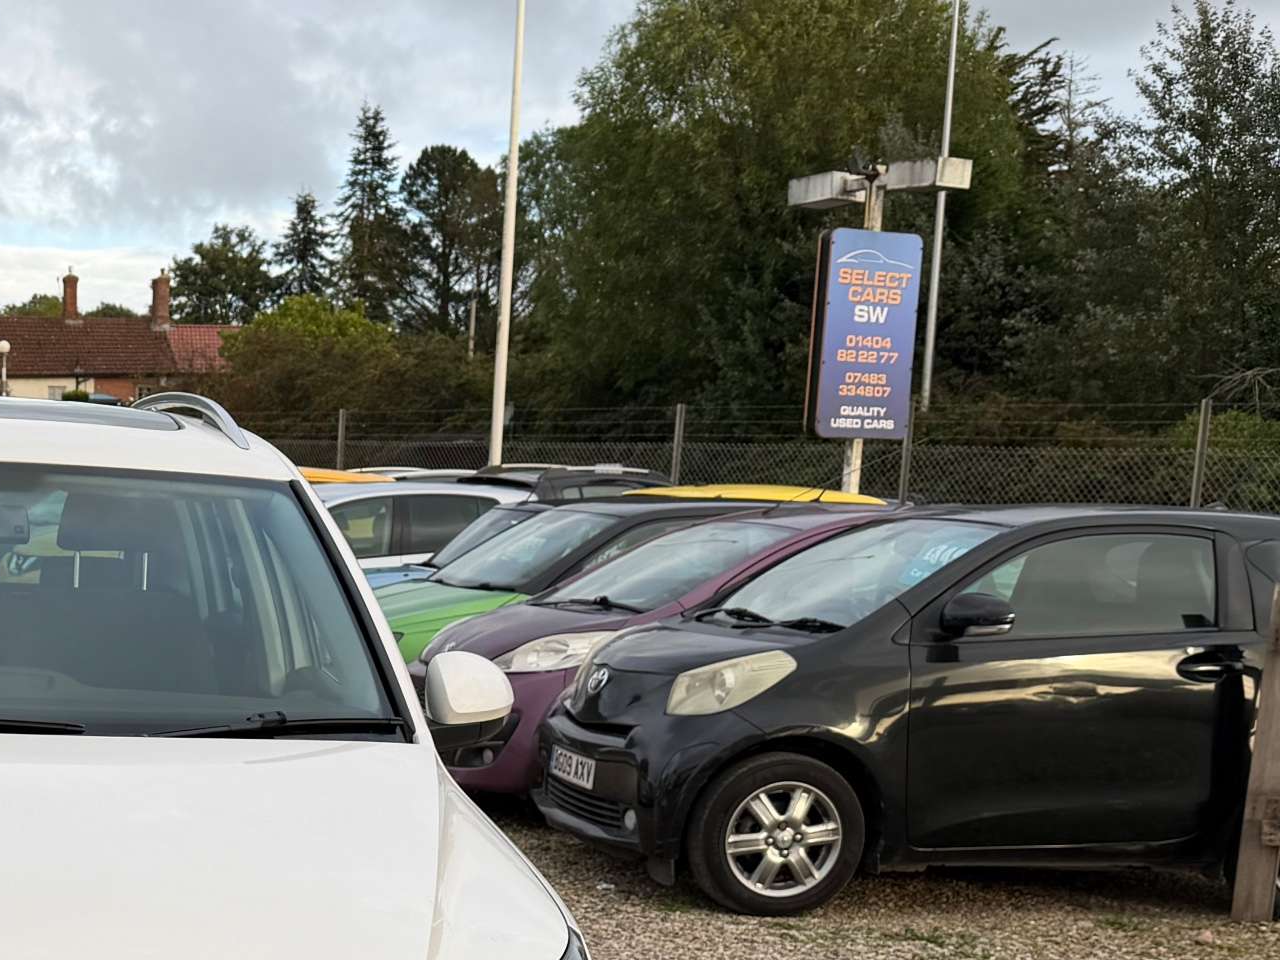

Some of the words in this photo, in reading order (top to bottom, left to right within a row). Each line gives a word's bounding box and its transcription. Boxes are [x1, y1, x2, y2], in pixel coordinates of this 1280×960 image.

[838, 268, 912, 288] SELECT
[848, 286, 902, 305] CARS
[853, 304, 888, 324] SW
[846, 335, 892, 349] 01404
[845, 372, 887, 385] 07483
[840, 405, 887, 417] QUALITY
[830, 417, 862, 428] USED
[863, 418, 895, 430] CARS
